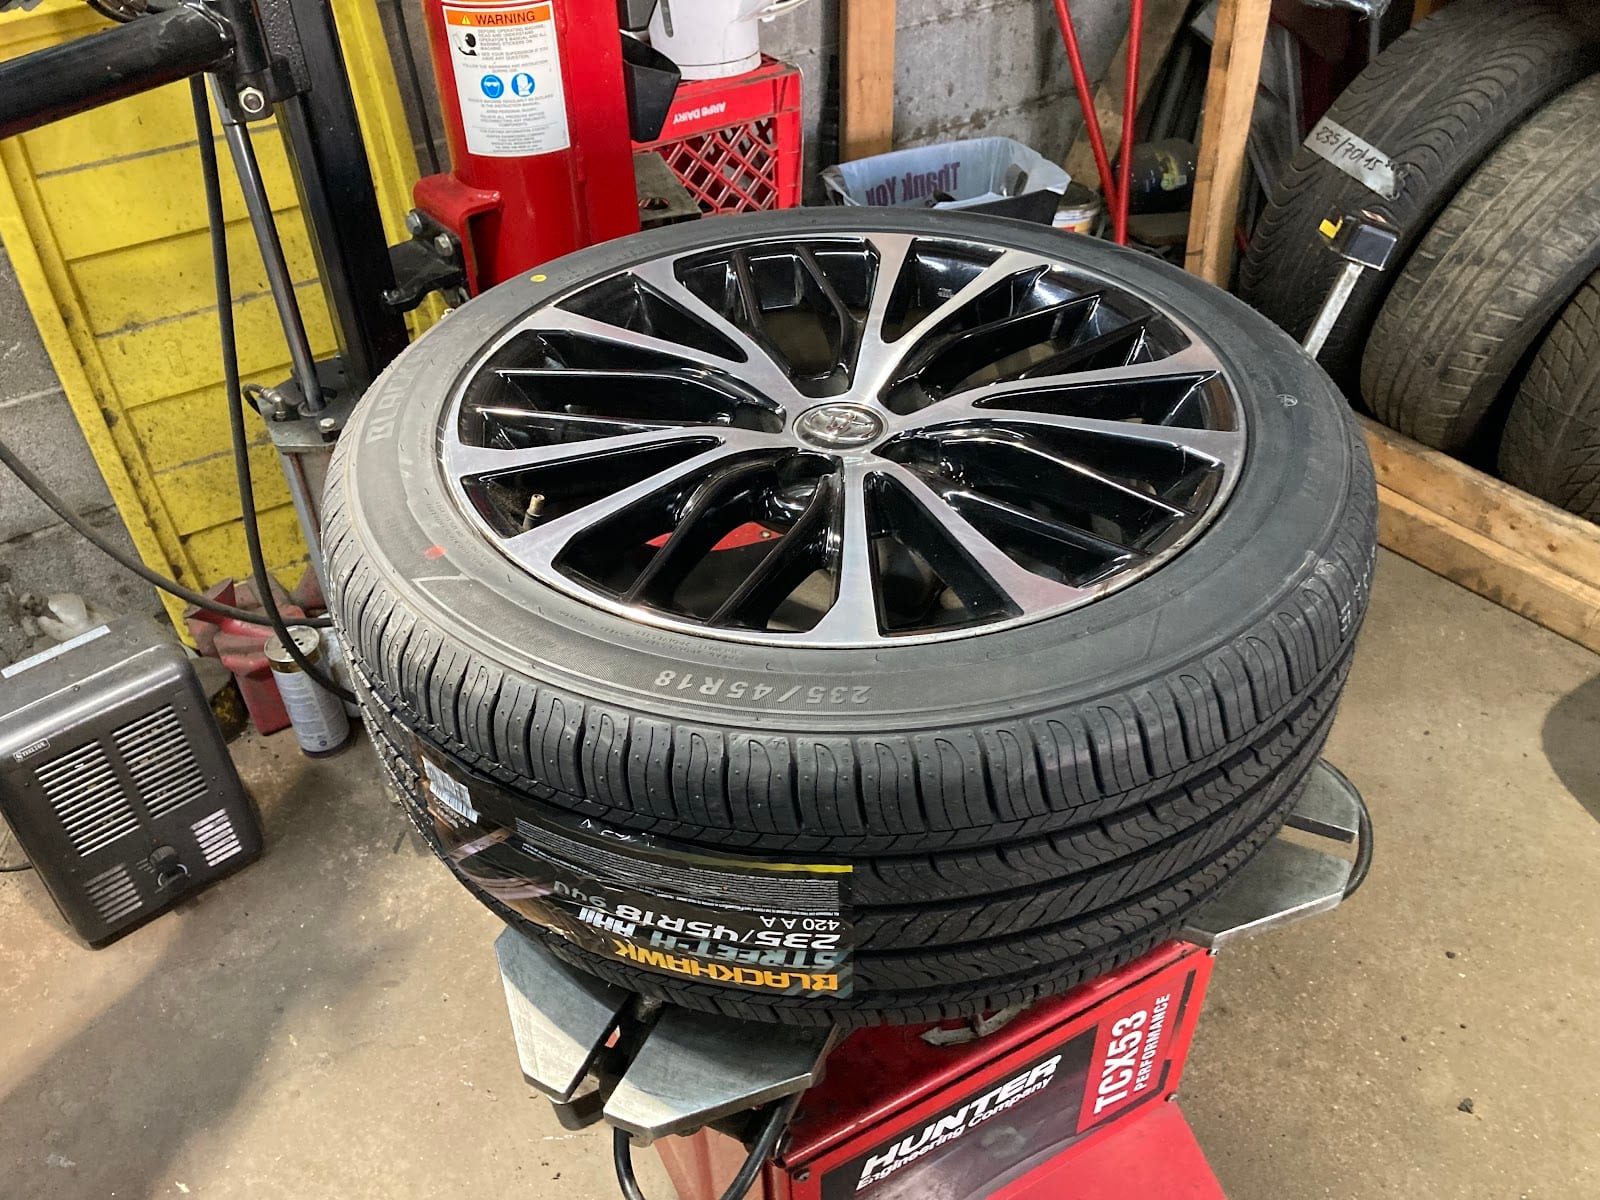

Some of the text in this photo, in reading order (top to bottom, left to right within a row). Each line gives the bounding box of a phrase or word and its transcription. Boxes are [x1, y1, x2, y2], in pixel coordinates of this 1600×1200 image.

[475, 11, 535, 25] WARNING
[672, 108, 701, 125] DAIRY
[653, 669, 872, 704] 235/45R18
[615, 904, 841, 950] 235/45R18
[760, 915, 841, 931] 420 A A
[611, 938, 839, 991] BLACKHAWK
[650, 930, 840, 970] STREET-H
[1093, 1009, 1148, 1115] TCX53
[1133, 993, 1171, 1092] PERFORMANCE
[855, 1074, 1054, 1191] Engineering Company
[860, 1054, 1062, 1178] HUNTER
